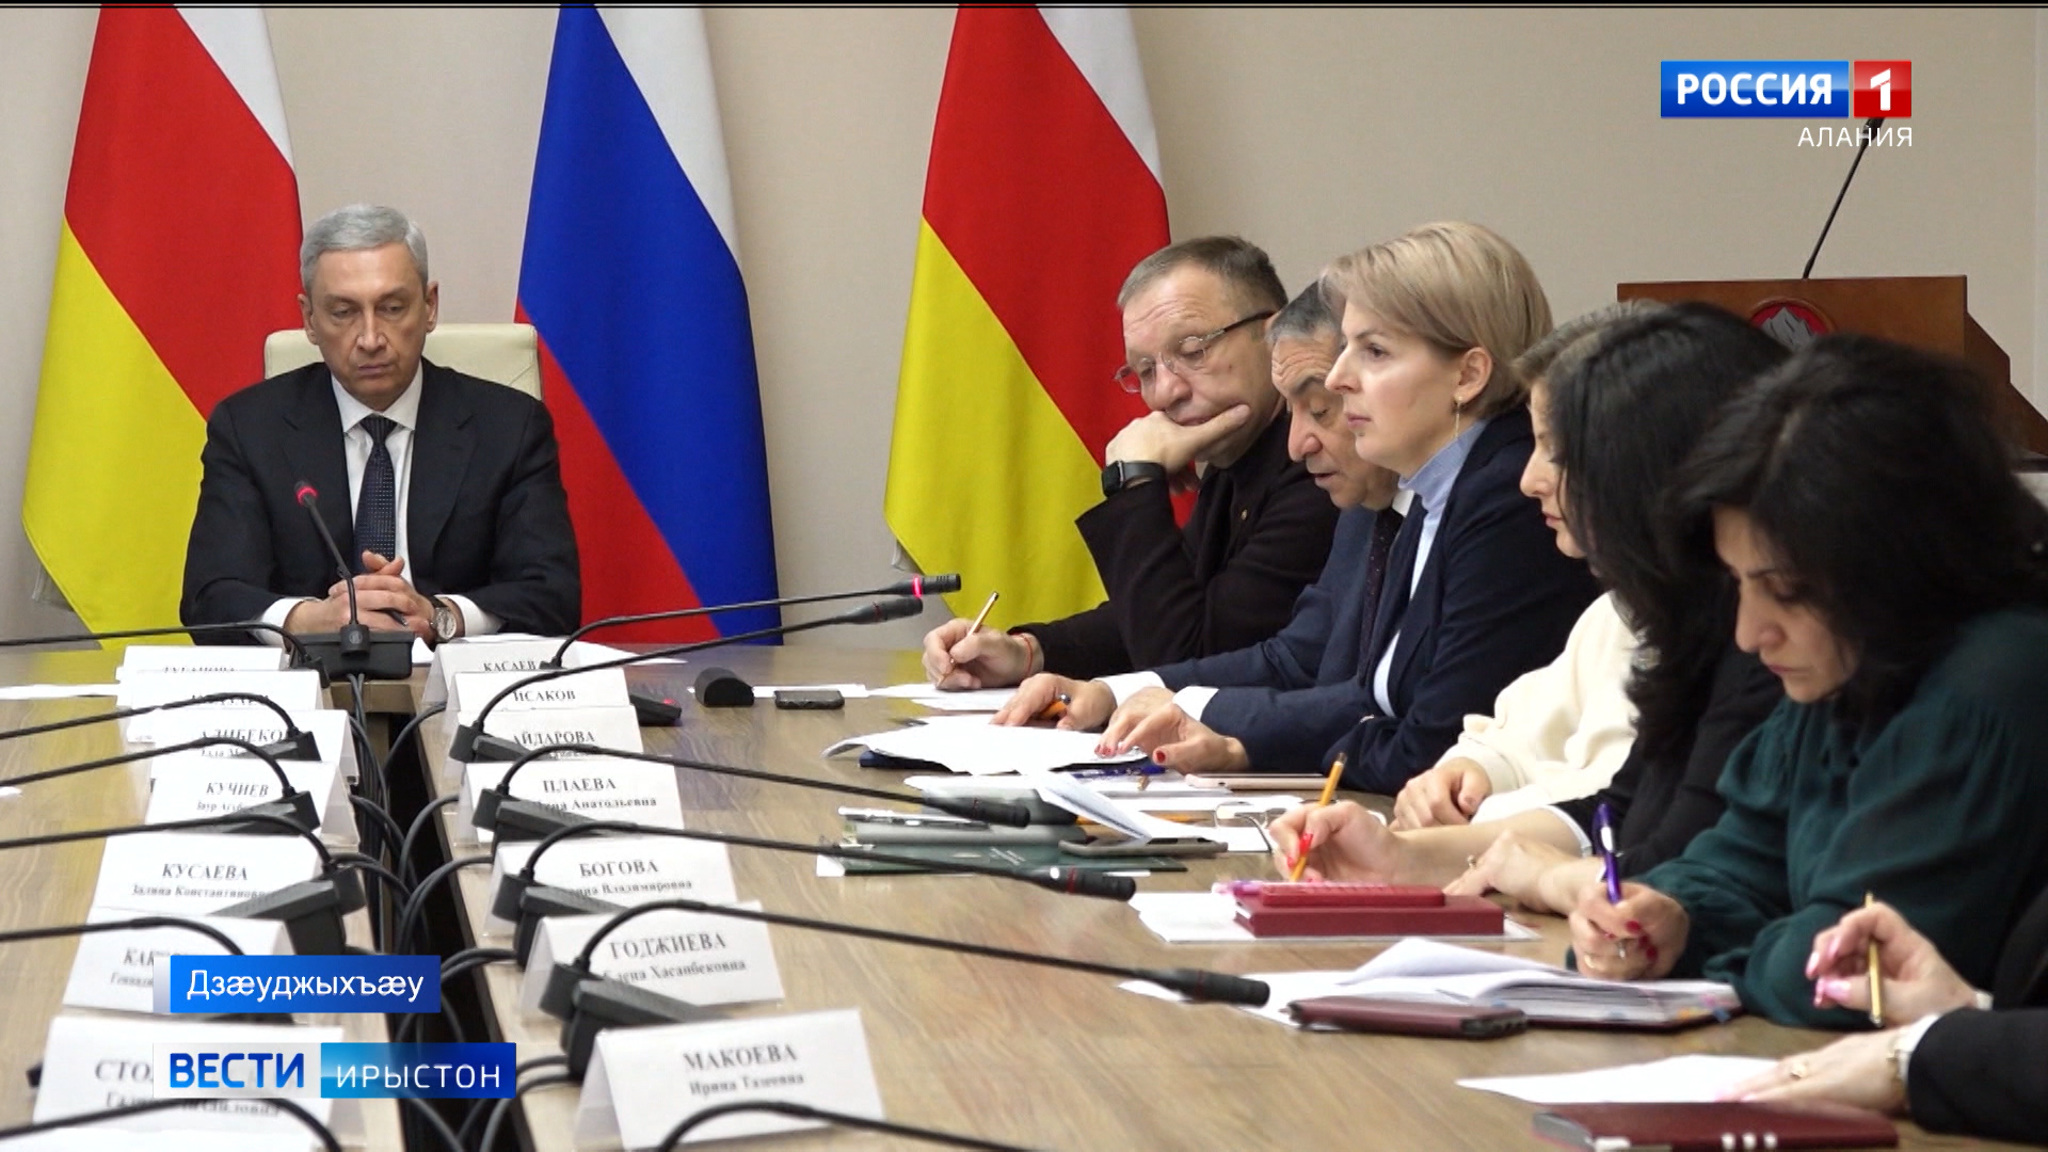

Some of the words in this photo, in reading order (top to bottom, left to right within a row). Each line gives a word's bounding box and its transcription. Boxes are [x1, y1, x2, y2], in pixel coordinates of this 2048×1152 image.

[206, 781, 269, 798] КУЧИЕВ
[543, 777, 617, 794] ПЛАЕВА
[162, 862, 248, 881] КУСАЕВА
[579, 859, 659, 879] БОГОВА
[175, 886, 268, 899] Константинов
[610, 932, 728, 960] ГОДЖИЕВА
[683, 1043, 799, 1071] МАКОЕВА
